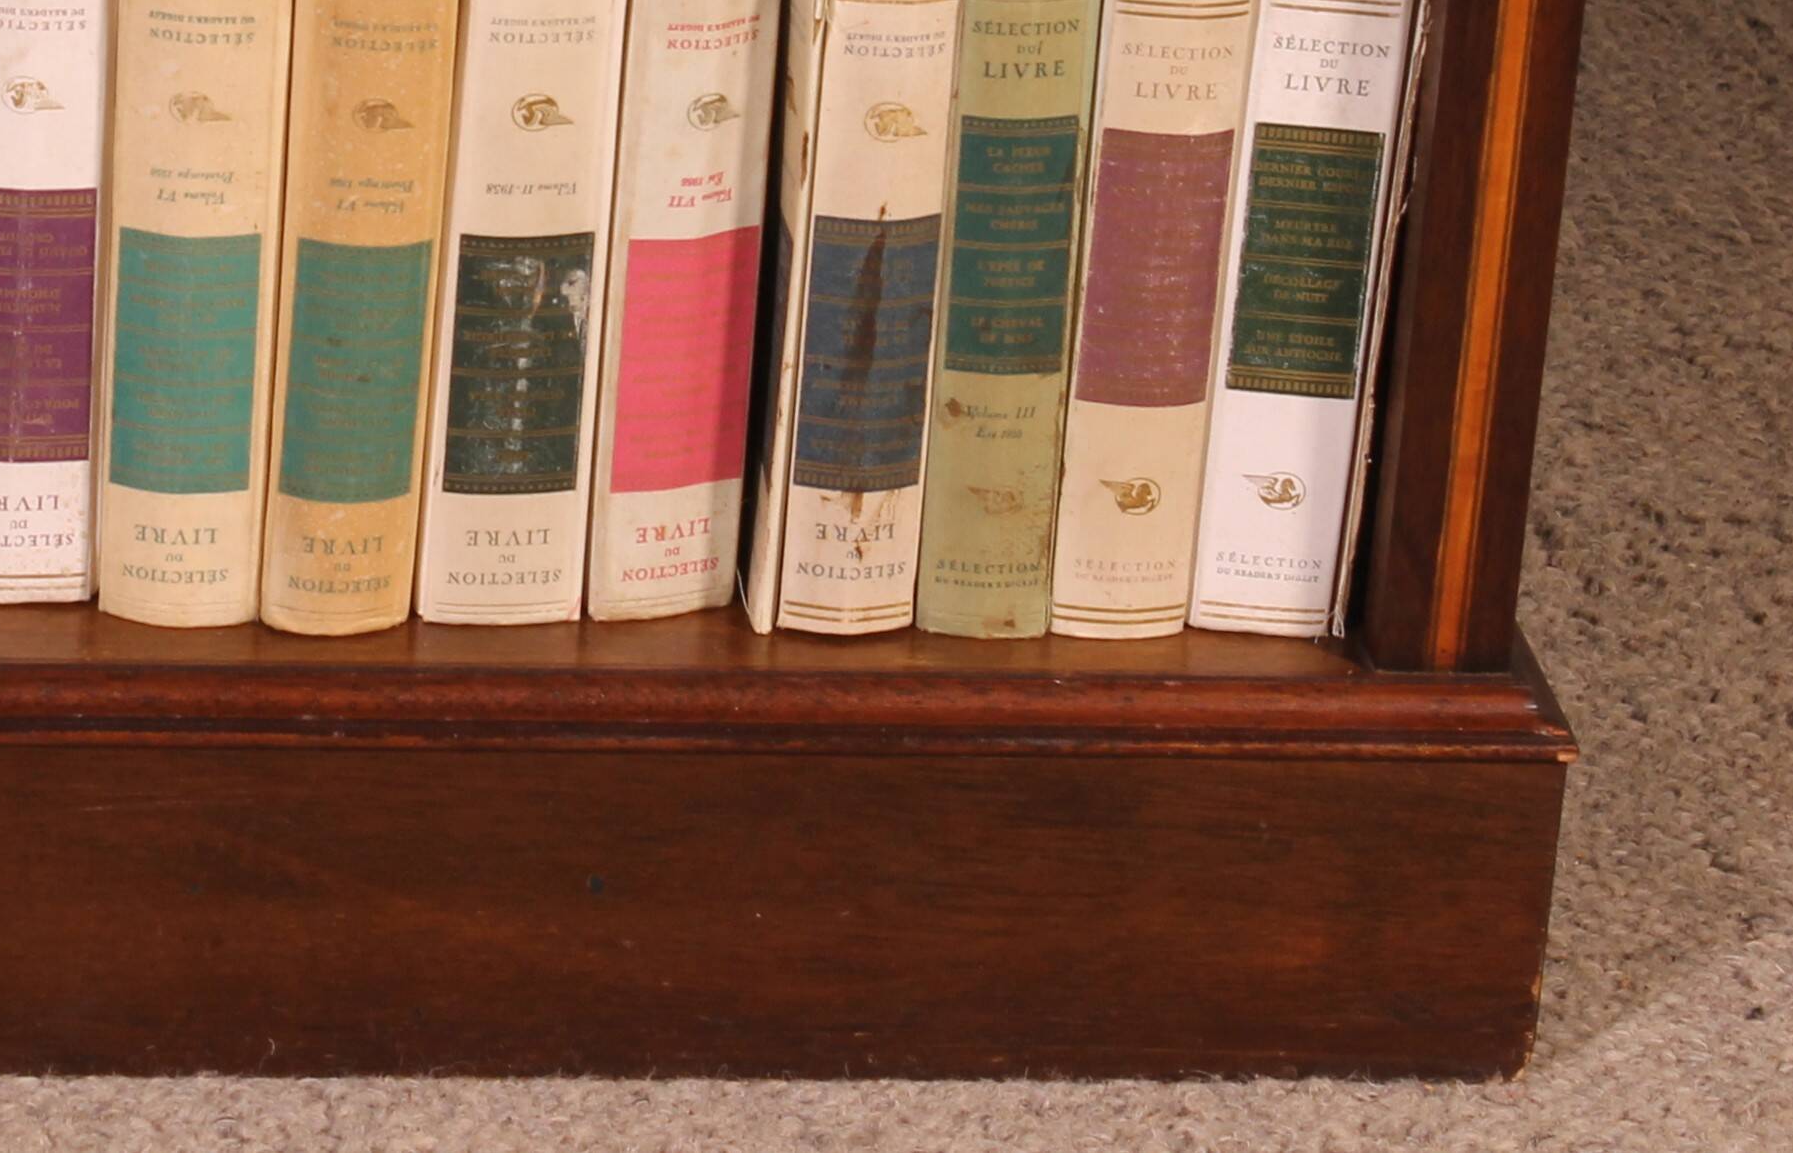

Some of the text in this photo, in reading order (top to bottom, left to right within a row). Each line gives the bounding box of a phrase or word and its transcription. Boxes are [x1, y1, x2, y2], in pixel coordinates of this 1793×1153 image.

[1017, 47, 1036, 55] DU
[983, 60, 1066, 80] LIVRE
[1170, 65, 1188, 75] DU
[1320, 58, 1339, 69] DU
[1134, 82, 1218, 101] LIVRE
[1285, 73, 1372, 97] LIVRE
[134, 524, 218, 545] LIVRE
[465, 528, 551, 547] LIVRE
[635, 517, 711, 544] LIVRE
[815, 523, 895, 542] LIVRE
[302, 536, 384, 555] LIVRE
